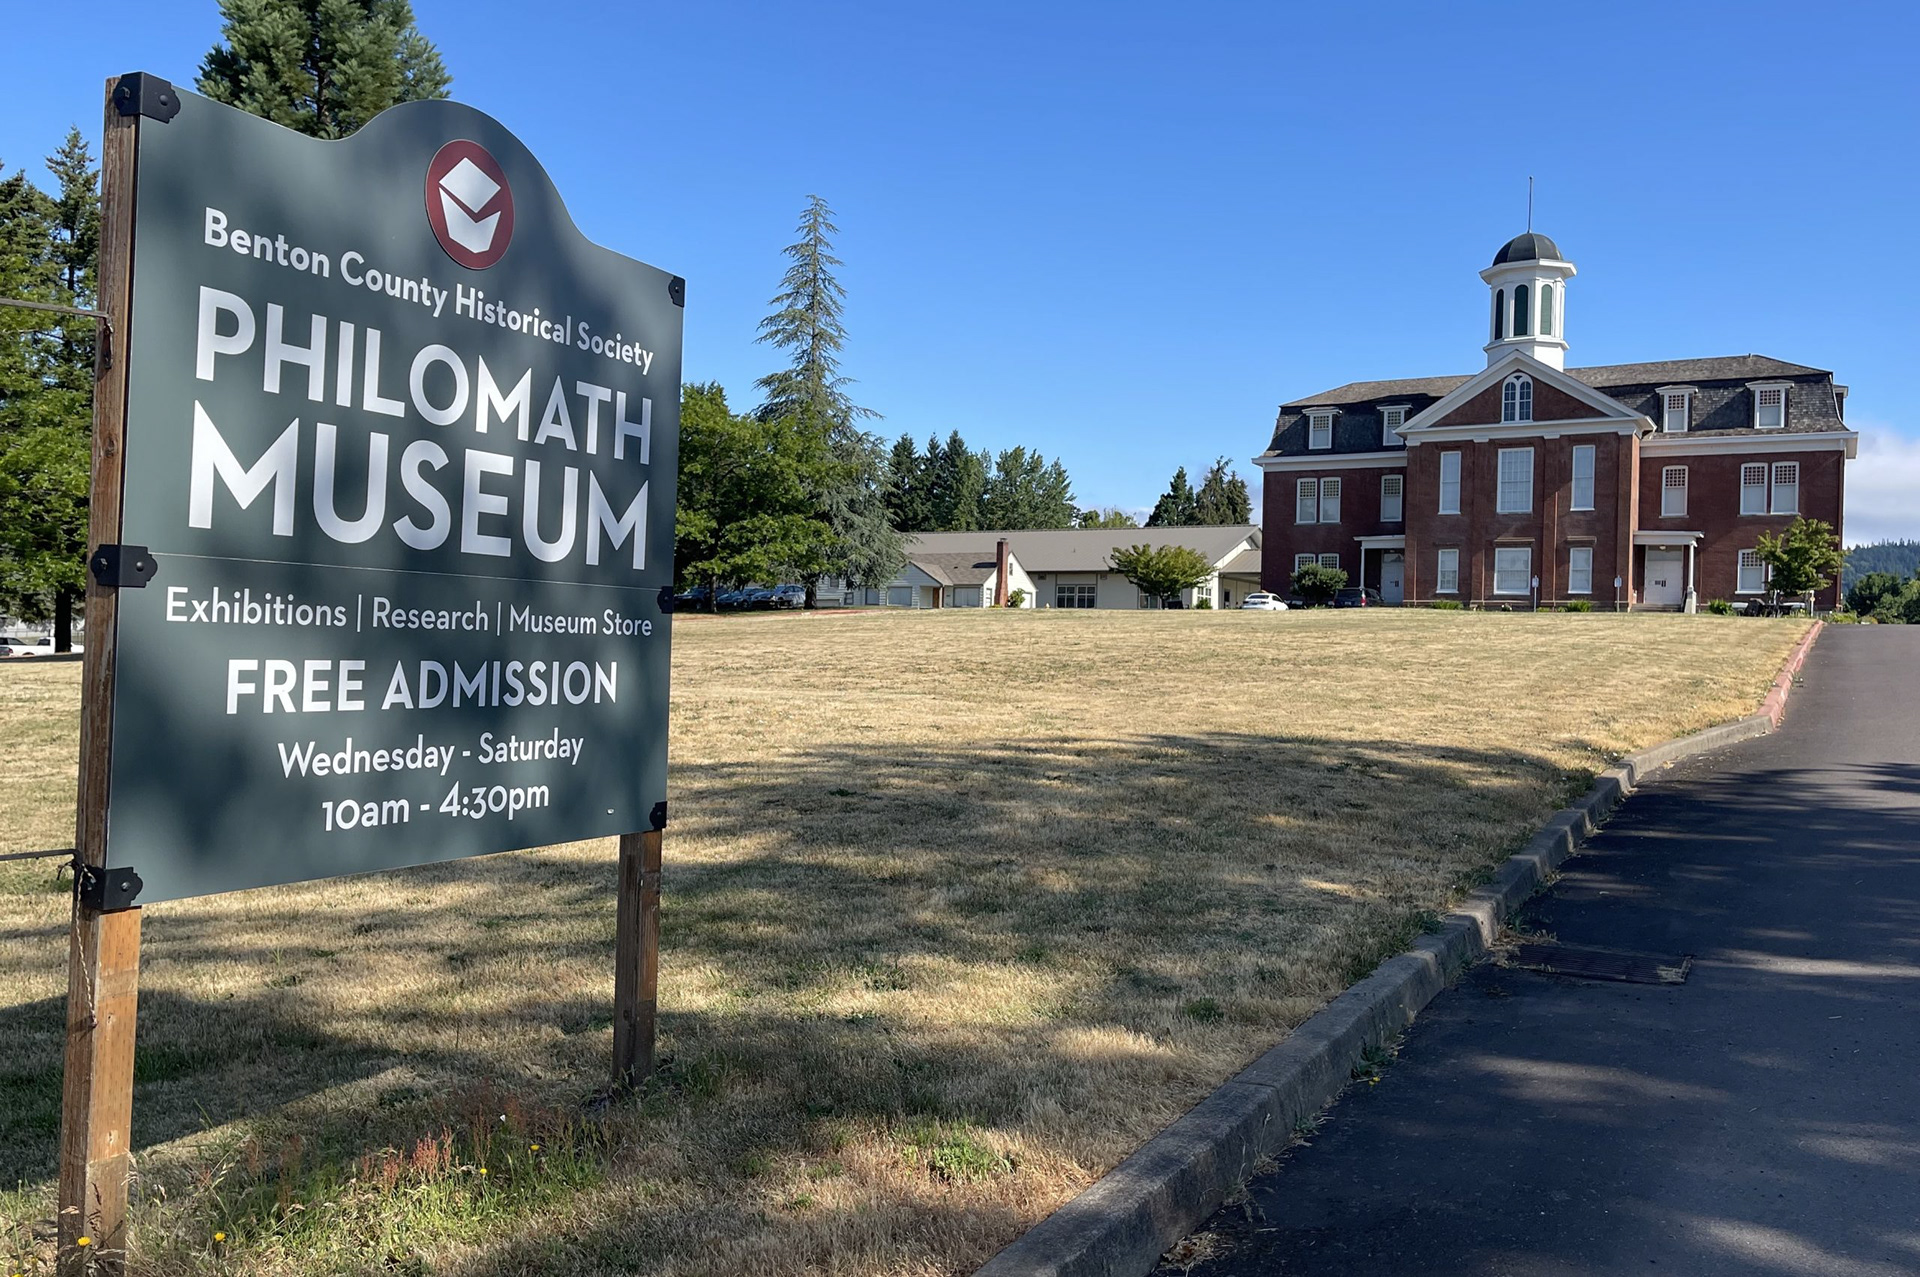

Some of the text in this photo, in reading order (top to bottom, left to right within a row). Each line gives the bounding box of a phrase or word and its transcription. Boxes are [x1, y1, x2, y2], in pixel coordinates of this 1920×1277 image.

[205, 206, 654, 376] Benton County Historical Society
[195, 285, 652, 465] PHILOMATH
[188, 399, 649, 570] MUSEUM
[165, 585, 347, 628] Exhibitions
[372, 596, 489, 631] Research
[509, 604, 597, 635] Museum
[602, 608, 653, 637] Store
[226, 656, 618, 715] FREE ADMISSION
[277, 733, 456, 779] Wednesday
[477, 726, 584, 766] Saturday
[321, 798, 410, 832] 10am
[438, 780, 550, 821] 4:30pm
